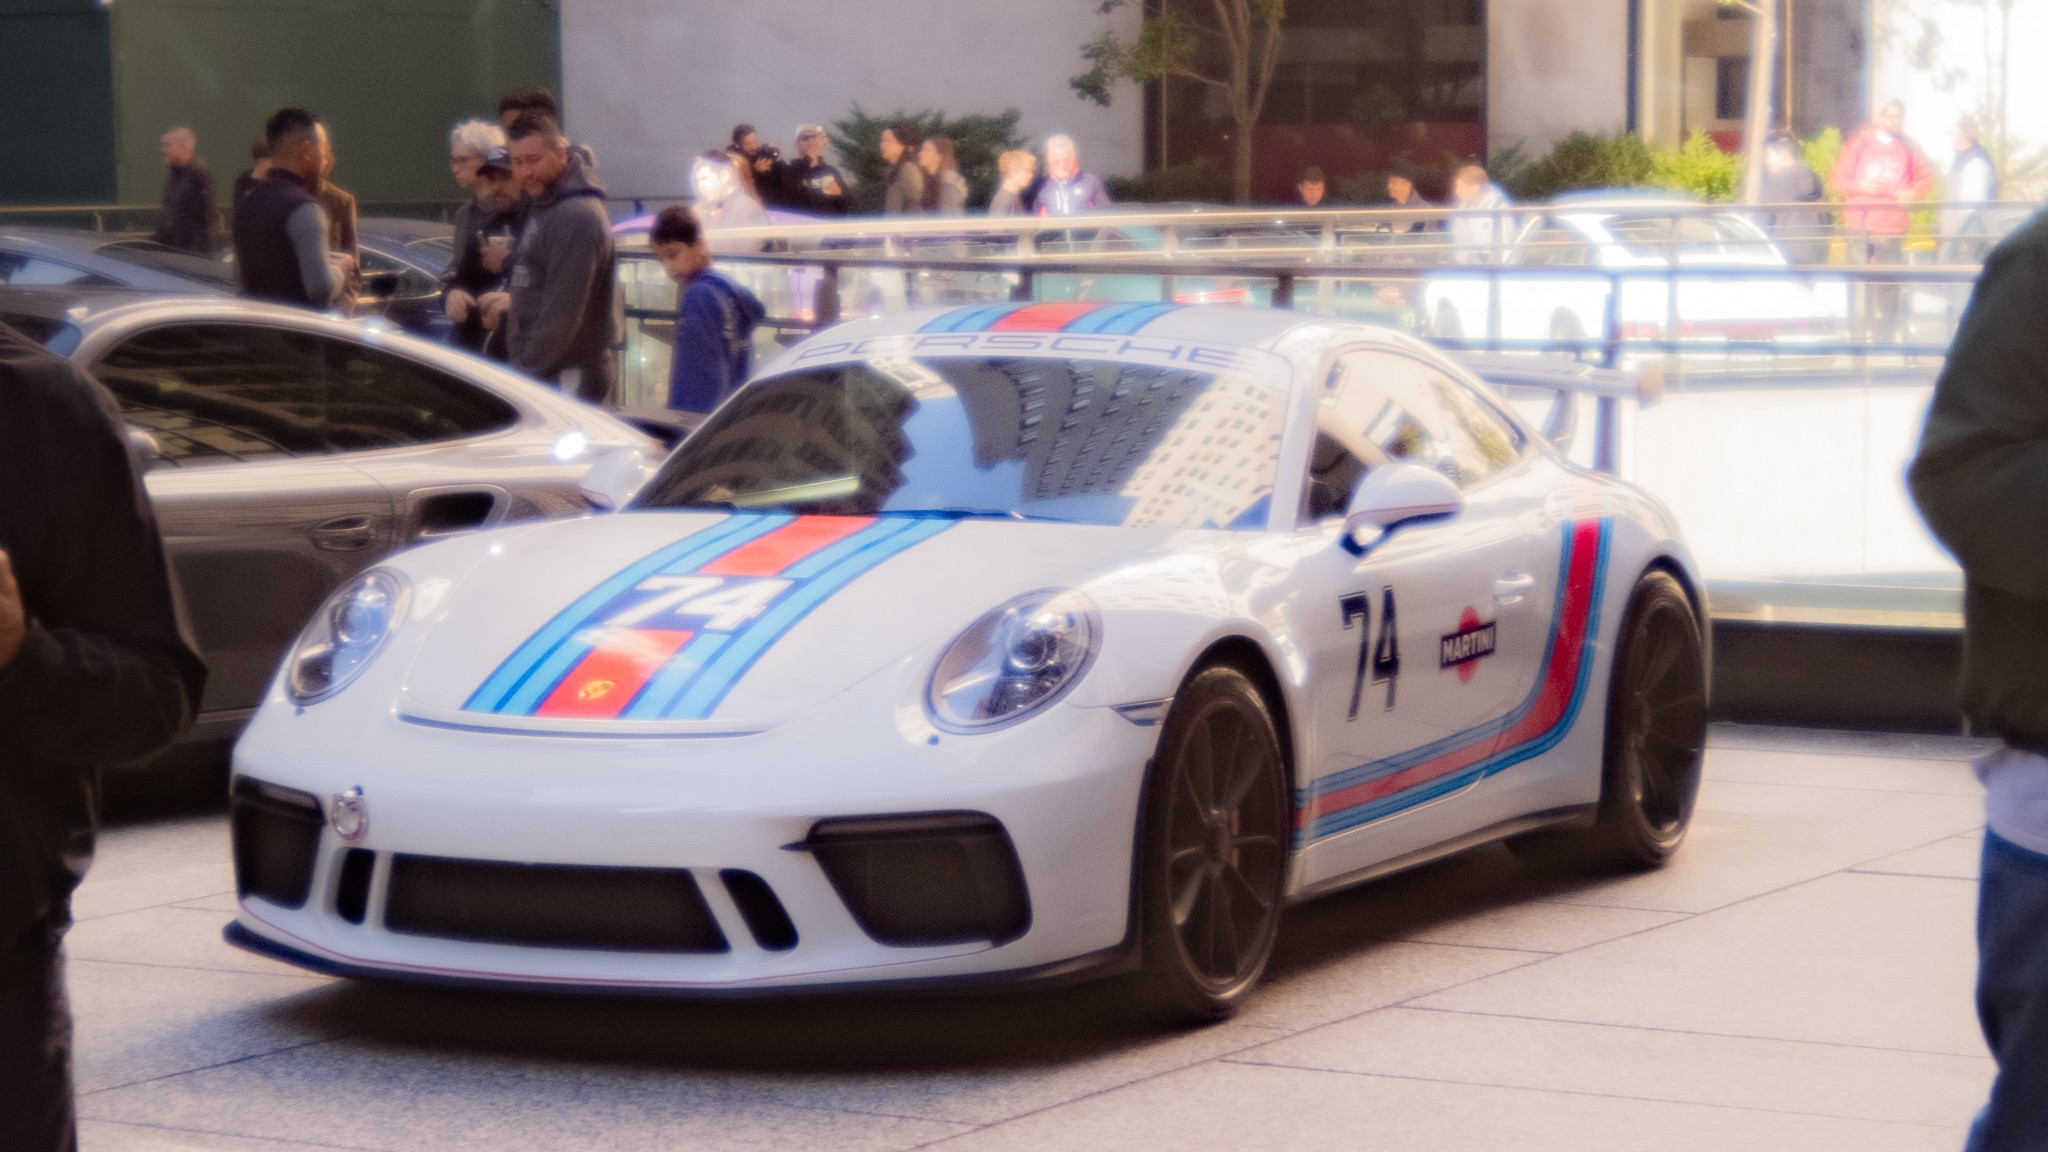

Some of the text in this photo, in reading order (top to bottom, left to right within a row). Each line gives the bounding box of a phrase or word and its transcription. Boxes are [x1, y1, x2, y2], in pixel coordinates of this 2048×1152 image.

[791, 334, 1258, 375] PORSCHE
[603, 576, 795, 630] 74
[1339, 585, 1399, 721] 74
[1442, 626, 1494, 664] MARTINI
